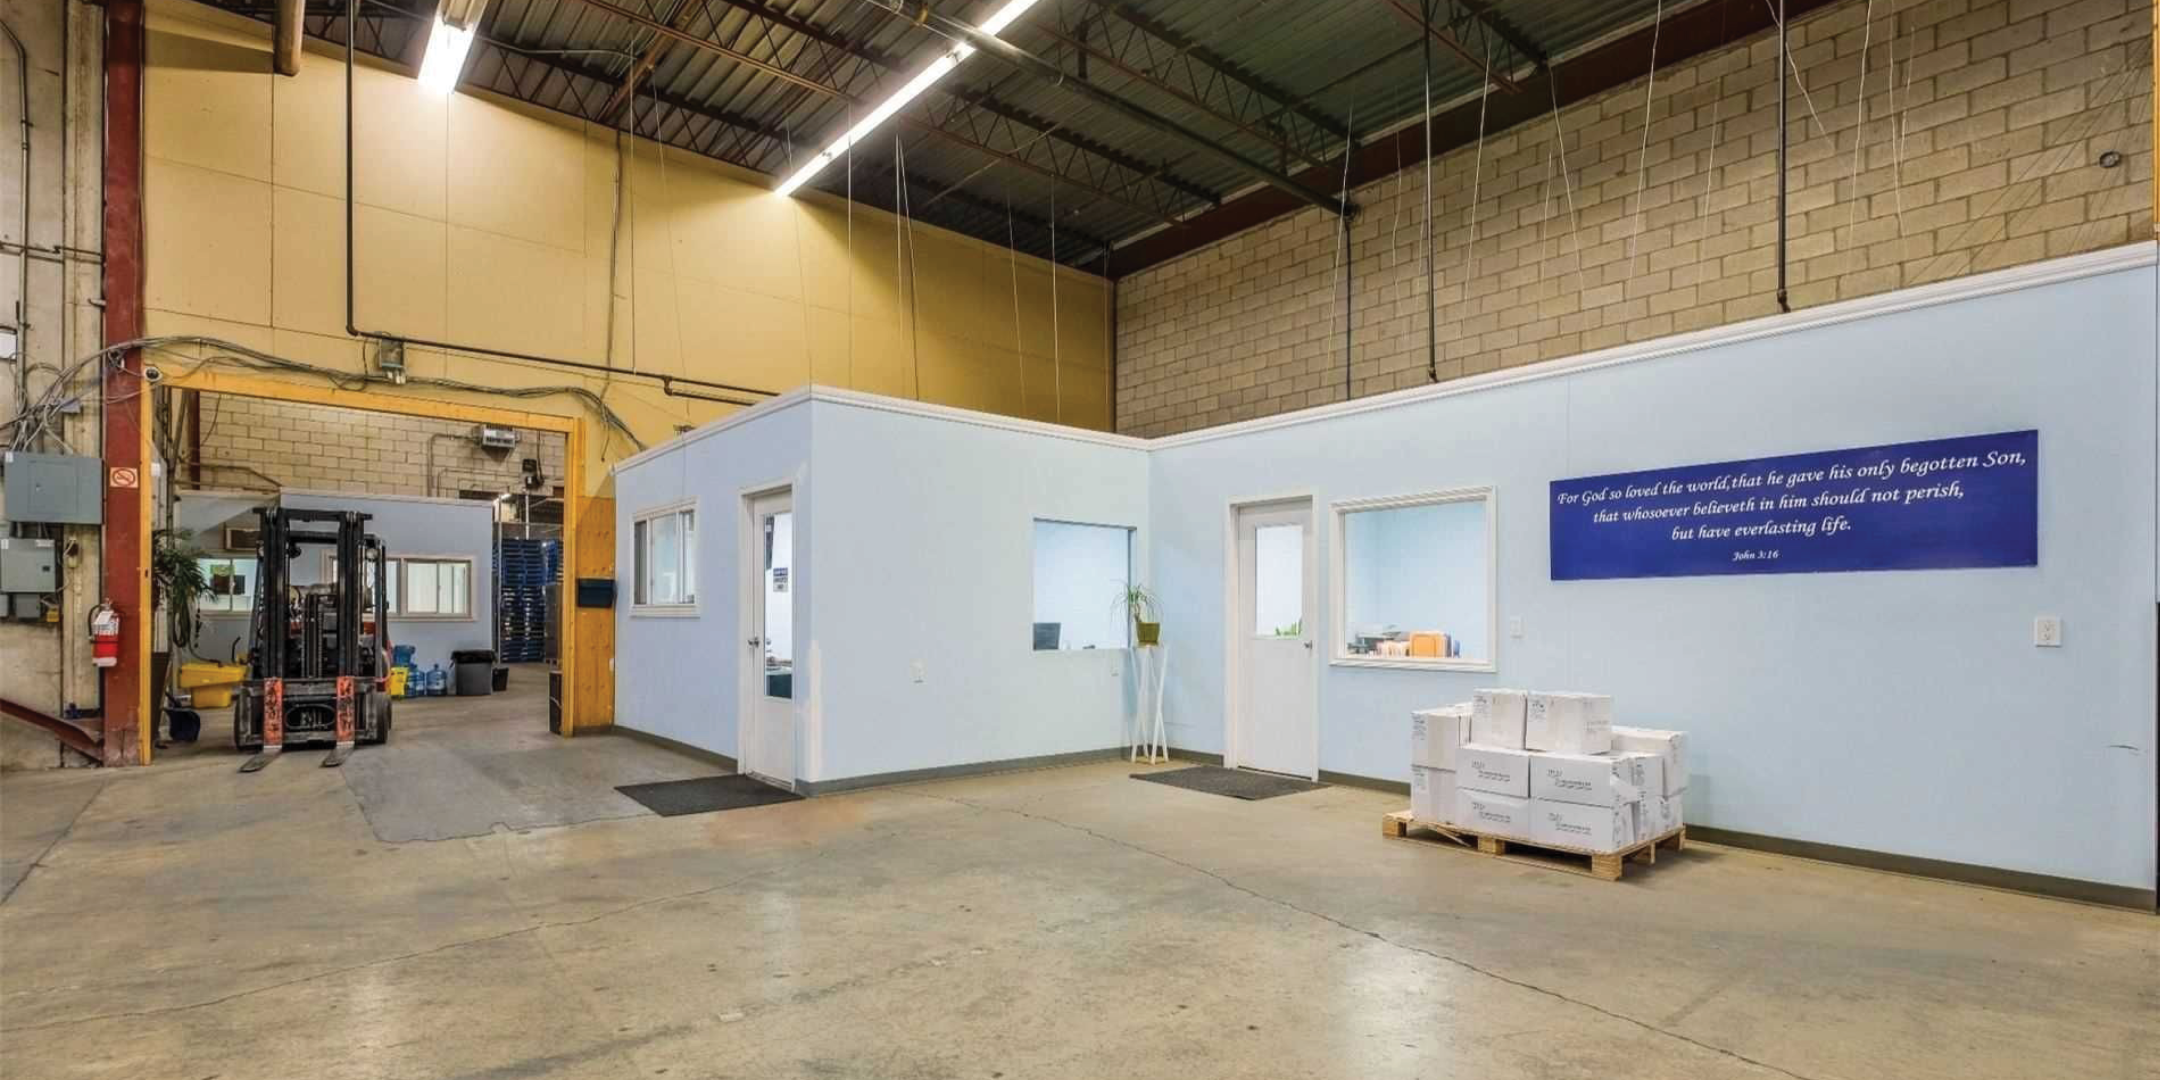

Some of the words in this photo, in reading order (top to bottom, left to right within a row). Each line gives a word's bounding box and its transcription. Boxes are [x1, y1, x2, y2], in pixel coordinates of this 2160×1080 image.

[1557, 492, 1579, 505] For
[1582, 487, 1609, 506] God
[1609, 490, 1622, 500] so
[1625, 482, 1661, 499] loved
[1662, 480, 1683, 495] the
[1766, 470, 1784, 486] he
[1785, 470, 1825, 488] gave
[1828, 464, 1853, 480] his
[1857, 459, 1895, 480] only
[1900, 457, 1979, 477] begotten
[1982, 450, 2027, 468] Son,
[1593, 508, 1619, 523] that
[1623, 505, 1690, 521] whosoever
[1693, 497, 1755, 515] believeth
[1760, 496, 1774, 510] in
[1779, 494, 1808, 509] him
[1811, 488, 1870, 506] should
[1871, 489, 1900, 503] not
[1905, 480, 1964, 505] perish,
[1671, 525, 1694, 541] but
[1698, 523, 1731, 539] have
[1735, 519, 1817, 537] everlasting
[1821, 516, 1852, 537] life.
[1732, 549, 1756, 561] John
[1758, 549, 1780, 560] 3:16
